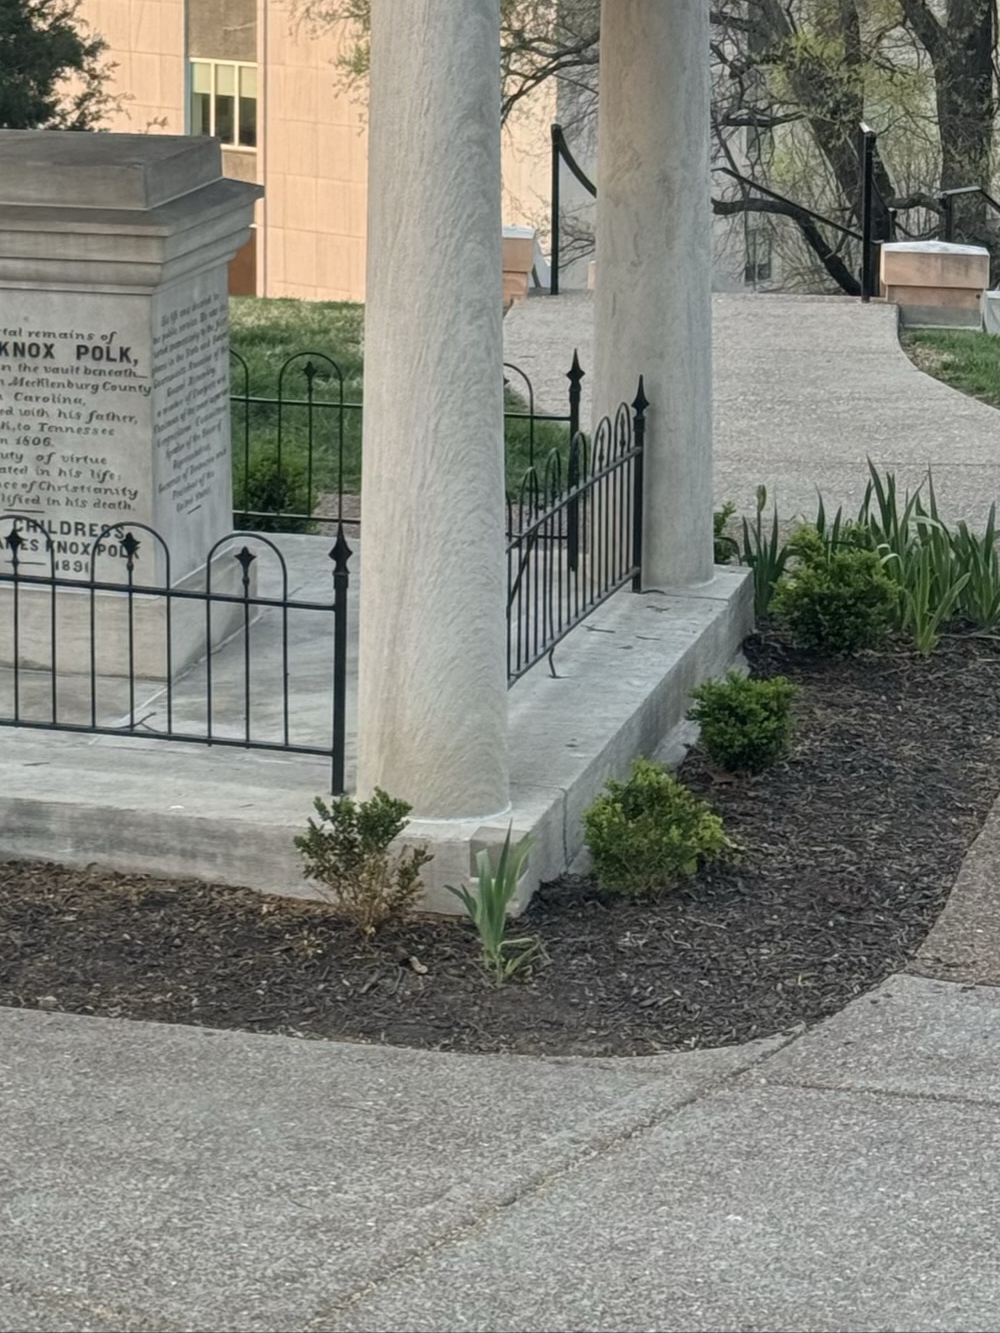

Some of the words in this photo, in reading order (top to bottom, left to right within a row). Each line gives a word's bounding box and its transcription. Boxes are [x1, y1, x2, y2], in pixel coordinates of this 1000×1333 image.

[27, 329, 95, 341] remains
[101, 331, 117, 344] of
[76, 344, 138, 366] POLK,
[17, 362, 39, 373] the
[43, 365, 80, 375] vault
[102, 381, 152, 397] County
[14, 392, 86, 406] Carolina,
[18, 407, 49, 418] with
[57, 408, 82, 420] his
[85, 410, 138, 425] father,
[38, 422, 115, 436] Tennessee
[15, 435, 54, 447] 1806.
[36, 452, 56, 465] of
[61, 453, 108, 465] virtue
[36, 466, 51, 477] in
[58, 467, 82, 478] his
[19, 479, 37, 493] of
[38, 481, 138, 500] Christianity
[47, 497, 61, 506] in
[65, 497, 88, 508] his
[93, 498, 136, 511] death.
[13, 518, 125, 539] CHILDRESS
